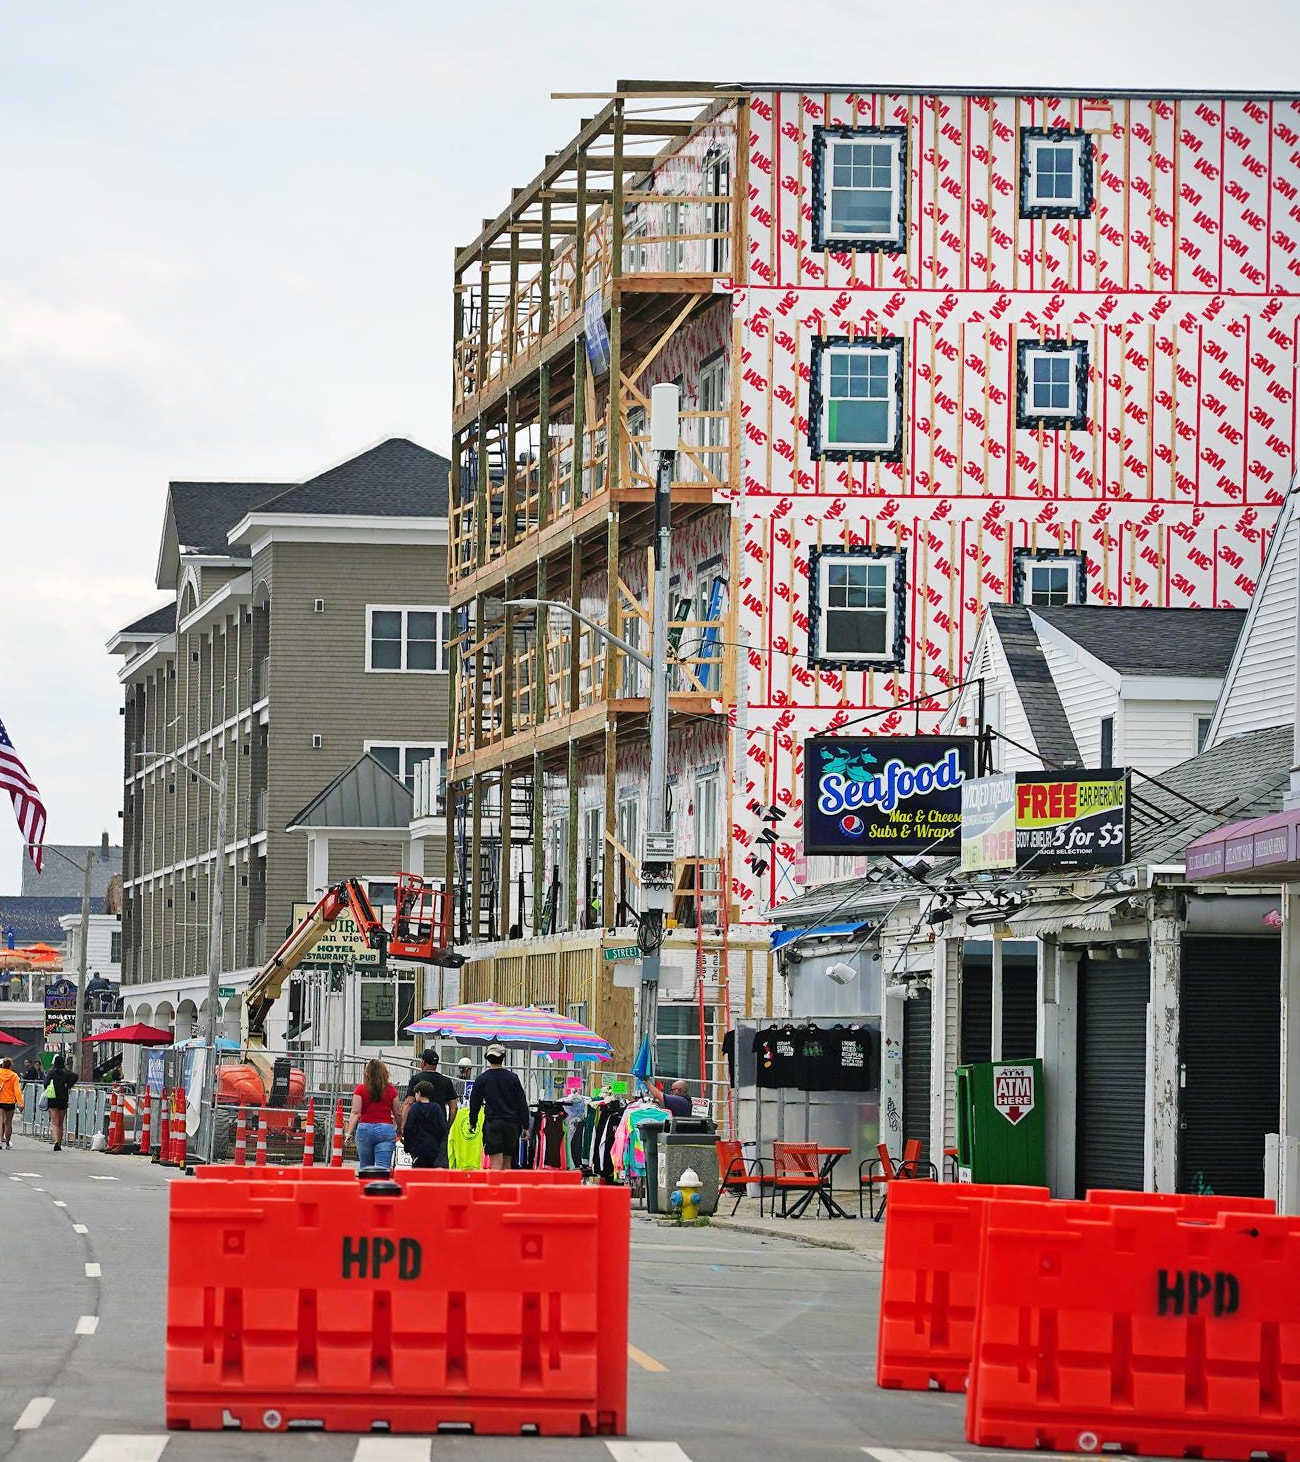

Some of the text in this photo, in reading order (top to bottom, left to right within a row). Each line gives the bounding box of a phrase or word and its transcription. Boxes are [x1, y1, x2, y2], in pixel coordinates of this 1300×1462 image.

[750, 96, 778, 123] 3M
[846, 91, 874, 118] 3M
[893, 104, 921, 131] 3M
[1195, 102, 1223, 129] 3M
[1243, 100, 1271, 127] 3M
[780, 120, 808, 147] 3M
[1224, 125, 1252, 152] 3M
[1272, 122, 1300, 149] 3M
[970, 143, 998, 170] 3M
[1194, 156, 1222, 183] 3M
[1242, 153, 1270, 180] 3M
[940, 175, 968, 202] 3M
[1100, 168, 1128, 195] 3M
[1223, 179, 1251, 206] 3M
[1271, 175, 1299, 202] 3M
[970, 197, 998, 224] 3M
[1193, 210, 1221, 237] 3M
[1241, 207, 1269, 234] 3M
[780, 227, 808, 254] 3M
[1051, 222, 1079, 249] 3M
[1100, 222, 1128, 249] 3M
[1222, 232, 1250, 259] 3M
[1270, 229, 1298, 256] 3M
[751, 257, 779, 284] 3M
[969, 250, 997, 277] 3M
[1192, 263, 1220, 290] 3M
[1240, 261, 1268, 288] 3M
[775, 289, 803, 316] 3M
[828, 290, 856, 317] 3M
[881, 291, 909, 318] 3M
[935, 292, 963, 319] 3M
[988, 292, 1016, 319] 3M
[1041, 293, 1069, 320] 3M
[1094, 293, 1122, 320] 3M
[1201, 294, 1229, 321] 3M
[1259, 296, 1287, 323] 3M
[1249, 351, 1277, 378] 3M
[743, 367, 771, 394] 3M
[1219, 367, 1247, 394] 3M
[1266, 379, 1294, 406] 3M
[915, 416, 943, 443] 3M
[1248, 405, 1276, 432] 3M
[1218, 420, 1246, 447] 3M
[1265, 433, 1293, 460] 3M
[771, 437, 799, 464] 3M
[980, 434, 1008, 461] 3M
[1058, 438, 1086, 465] 3M
[1199, 446, 1227, 473] 3M
[789, 465, 817, 492] 3M
[885, 456, 913, 483] 3M
[962, 460, 990, 487] 3M
[1076, 466, 1104, 493] 3M
[1247, 458, 1275, 485] 3M
[887, 517, 915, 544] 3M
[1234, 505, 1262, 532] 3M
[774, 527, 802, 554] 3M
[917, 528, 945, 555] 3M
[1046, 519, 1074, 546] 3M
[1093, 527, 1121, 554] 3M
[744, 539, 772, 566] 3M
[1187, 546, 1215, 573] 3M
[1217, 544, 1245, 571] 3M
[934, 556, 962, 583] 3M
[773, 581, 801, 608] 3M
[916, 581, 944, 608] 3M
[982, 570, 1010, 597] 3M
[1092, 580, 1120, 607] 3M
[743, 592, 771, 619] 3M
[933, 609, 961, 636] 3M
[819, 668, 847, 695] 3M
[825, 708, 853, 735] 3M
[747, 743, 775, 770] 3M
[777, 733, 805, 760] 3M
[819, 748, 965, 815] Seafood
[776, 786, 804, 813] 3M
[1017, 783, 1123, 819] FREE EAR PIERCING
[889, 810, 913, 823] Mac
[915, 810, 925, 823] &
[869, 824, 955, 841] Subs & Wraps
[1017, 831, 1030, 848] BODY
[1052, 826, 1066, 846] 5
[1066, 826, 1095, 849] for
[1098, 822, 1123, 847] $5
[304, 953, 349, 961] STAURANT
[359, 954, 377, 962] PUB
[317, 945, 356, 953] HOTEL
[613, 947, 638, 959] STREET
[997, 1078, 1031, 1097] ATM
[997, 1096, 1031, 1105] HERE
[342, 1236, 422, 1280] HPD
[1158, 1269, 1240, 1317] HPD
